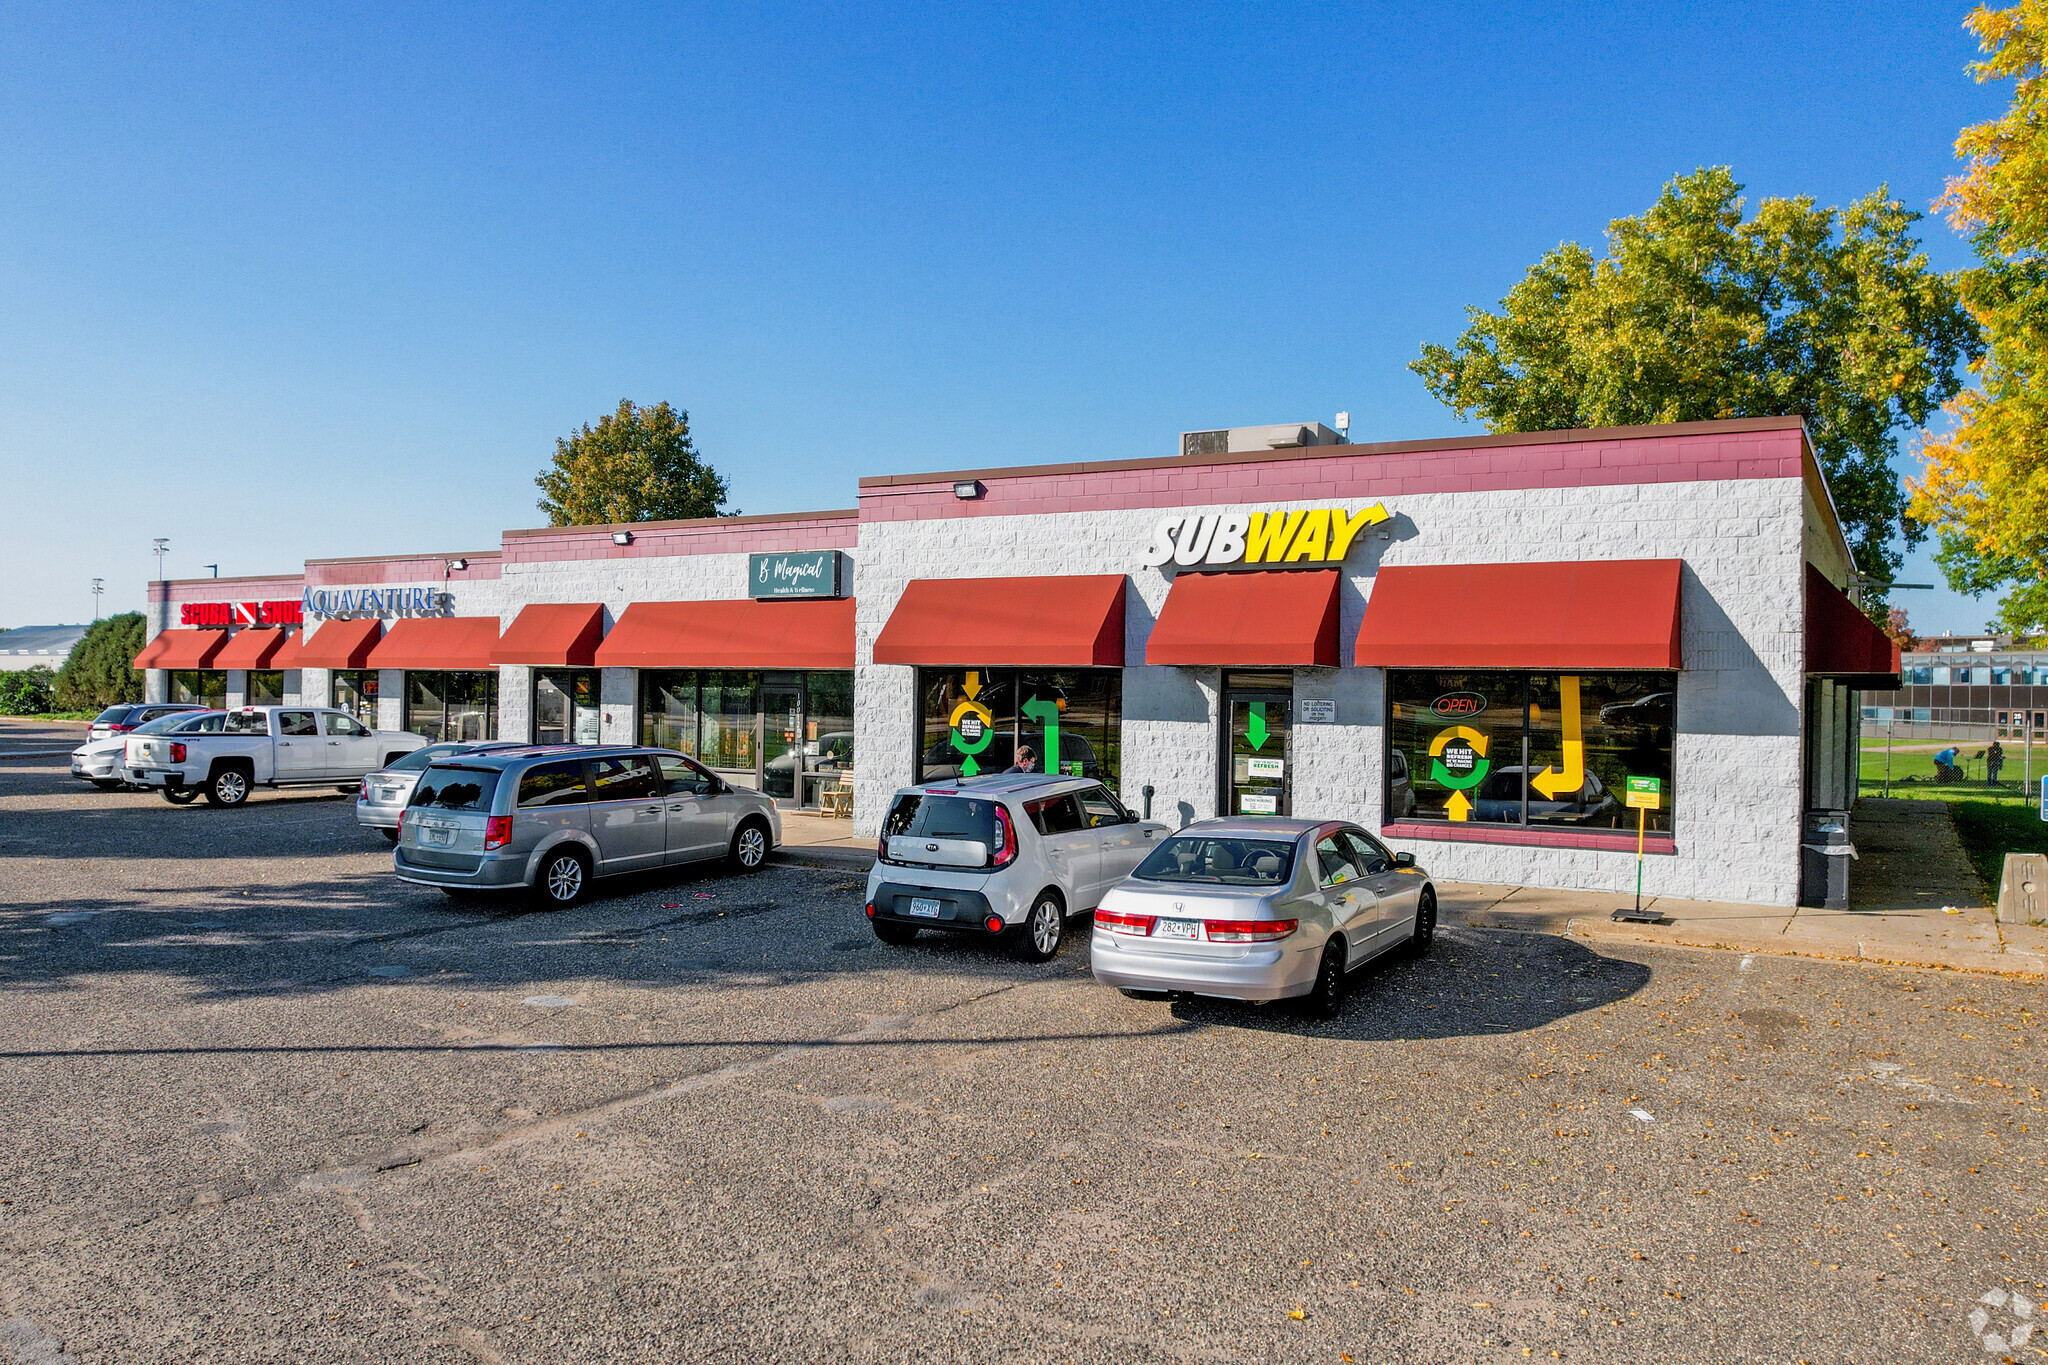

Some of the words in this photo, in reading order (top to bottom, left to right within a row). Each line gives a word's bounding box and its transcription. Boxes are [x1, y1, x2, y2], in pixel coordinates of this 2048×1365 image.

[1144, 502, 1389, 567] SUBWAY
[759, 557, 770, 583] B
[774, 556, 823, 585] Magical
[181, 602, 230, 625] SCUBA
[298, 585, 436, 616] AQUAVENTURE
[1438, 699, 1477, 712] OPEN
[1162, 922, 1176, 932] 282
[1182, 923, 1196, 934] VPH
